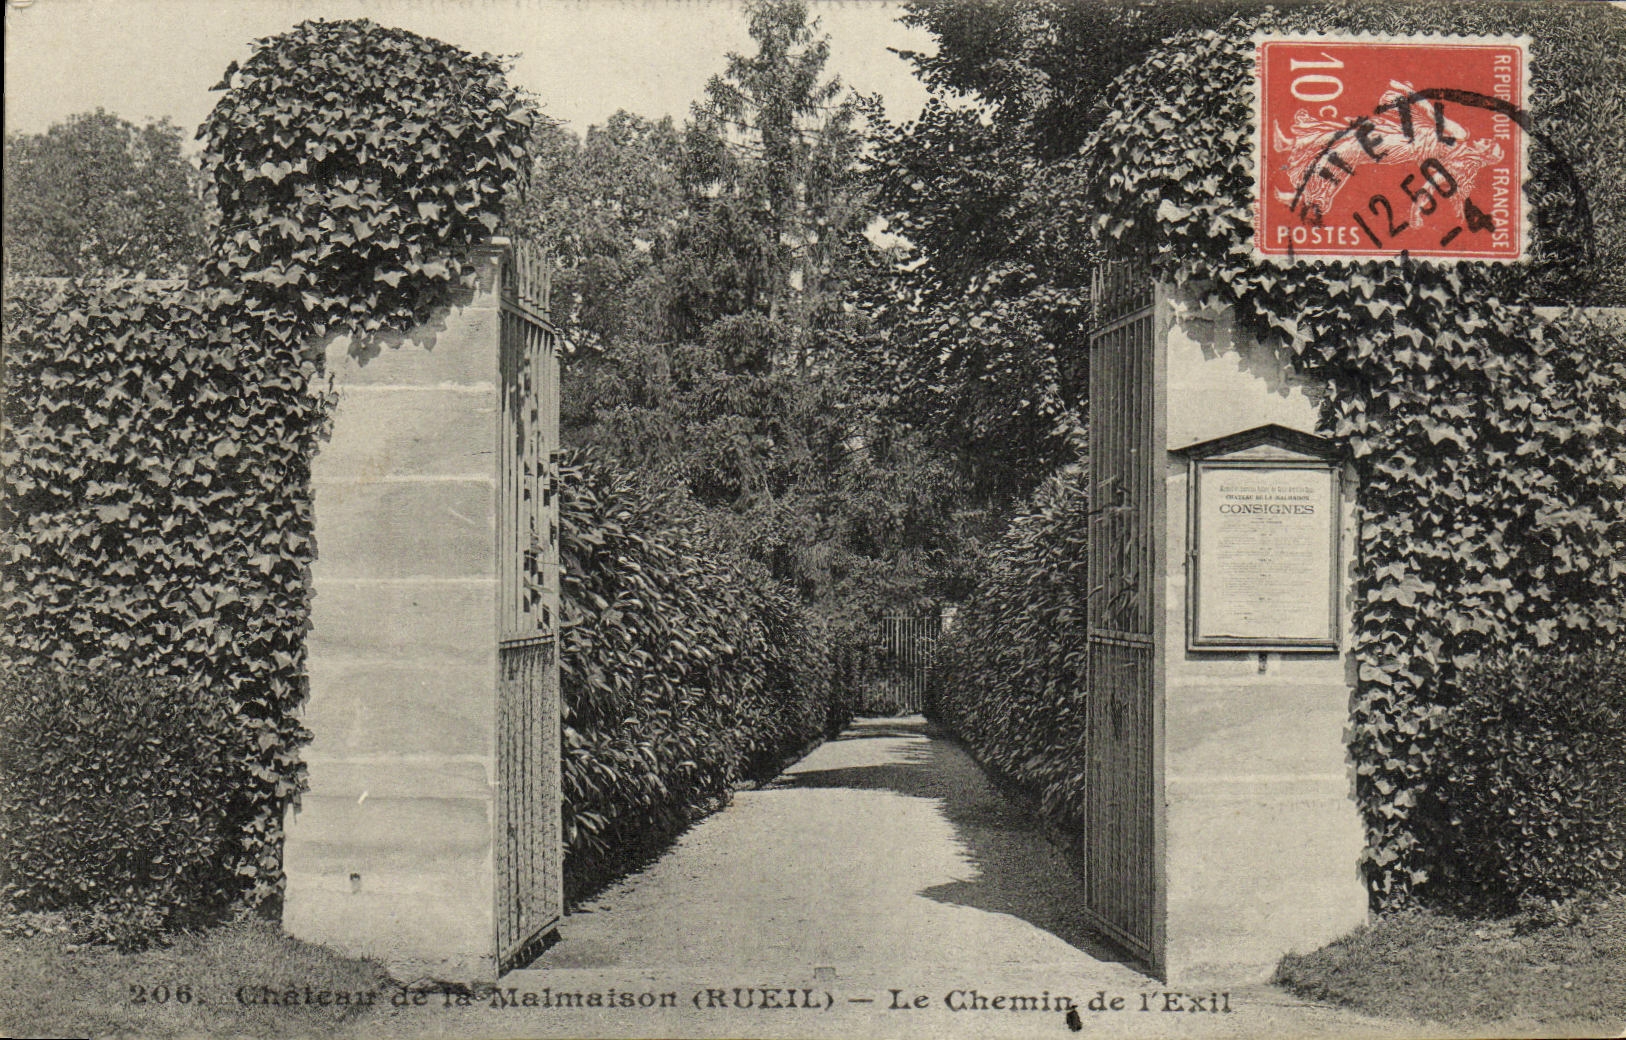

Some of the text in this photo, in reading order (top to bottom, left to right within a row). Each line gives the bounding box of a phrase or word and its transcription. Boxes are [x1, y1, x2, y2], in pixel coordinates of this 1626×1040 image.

[1493, 54, 1512, 141] REPUBQUE
[1277, 225, 1360, 246] POSTES
[1219, 504, 1315, 515] CONSIGNES
